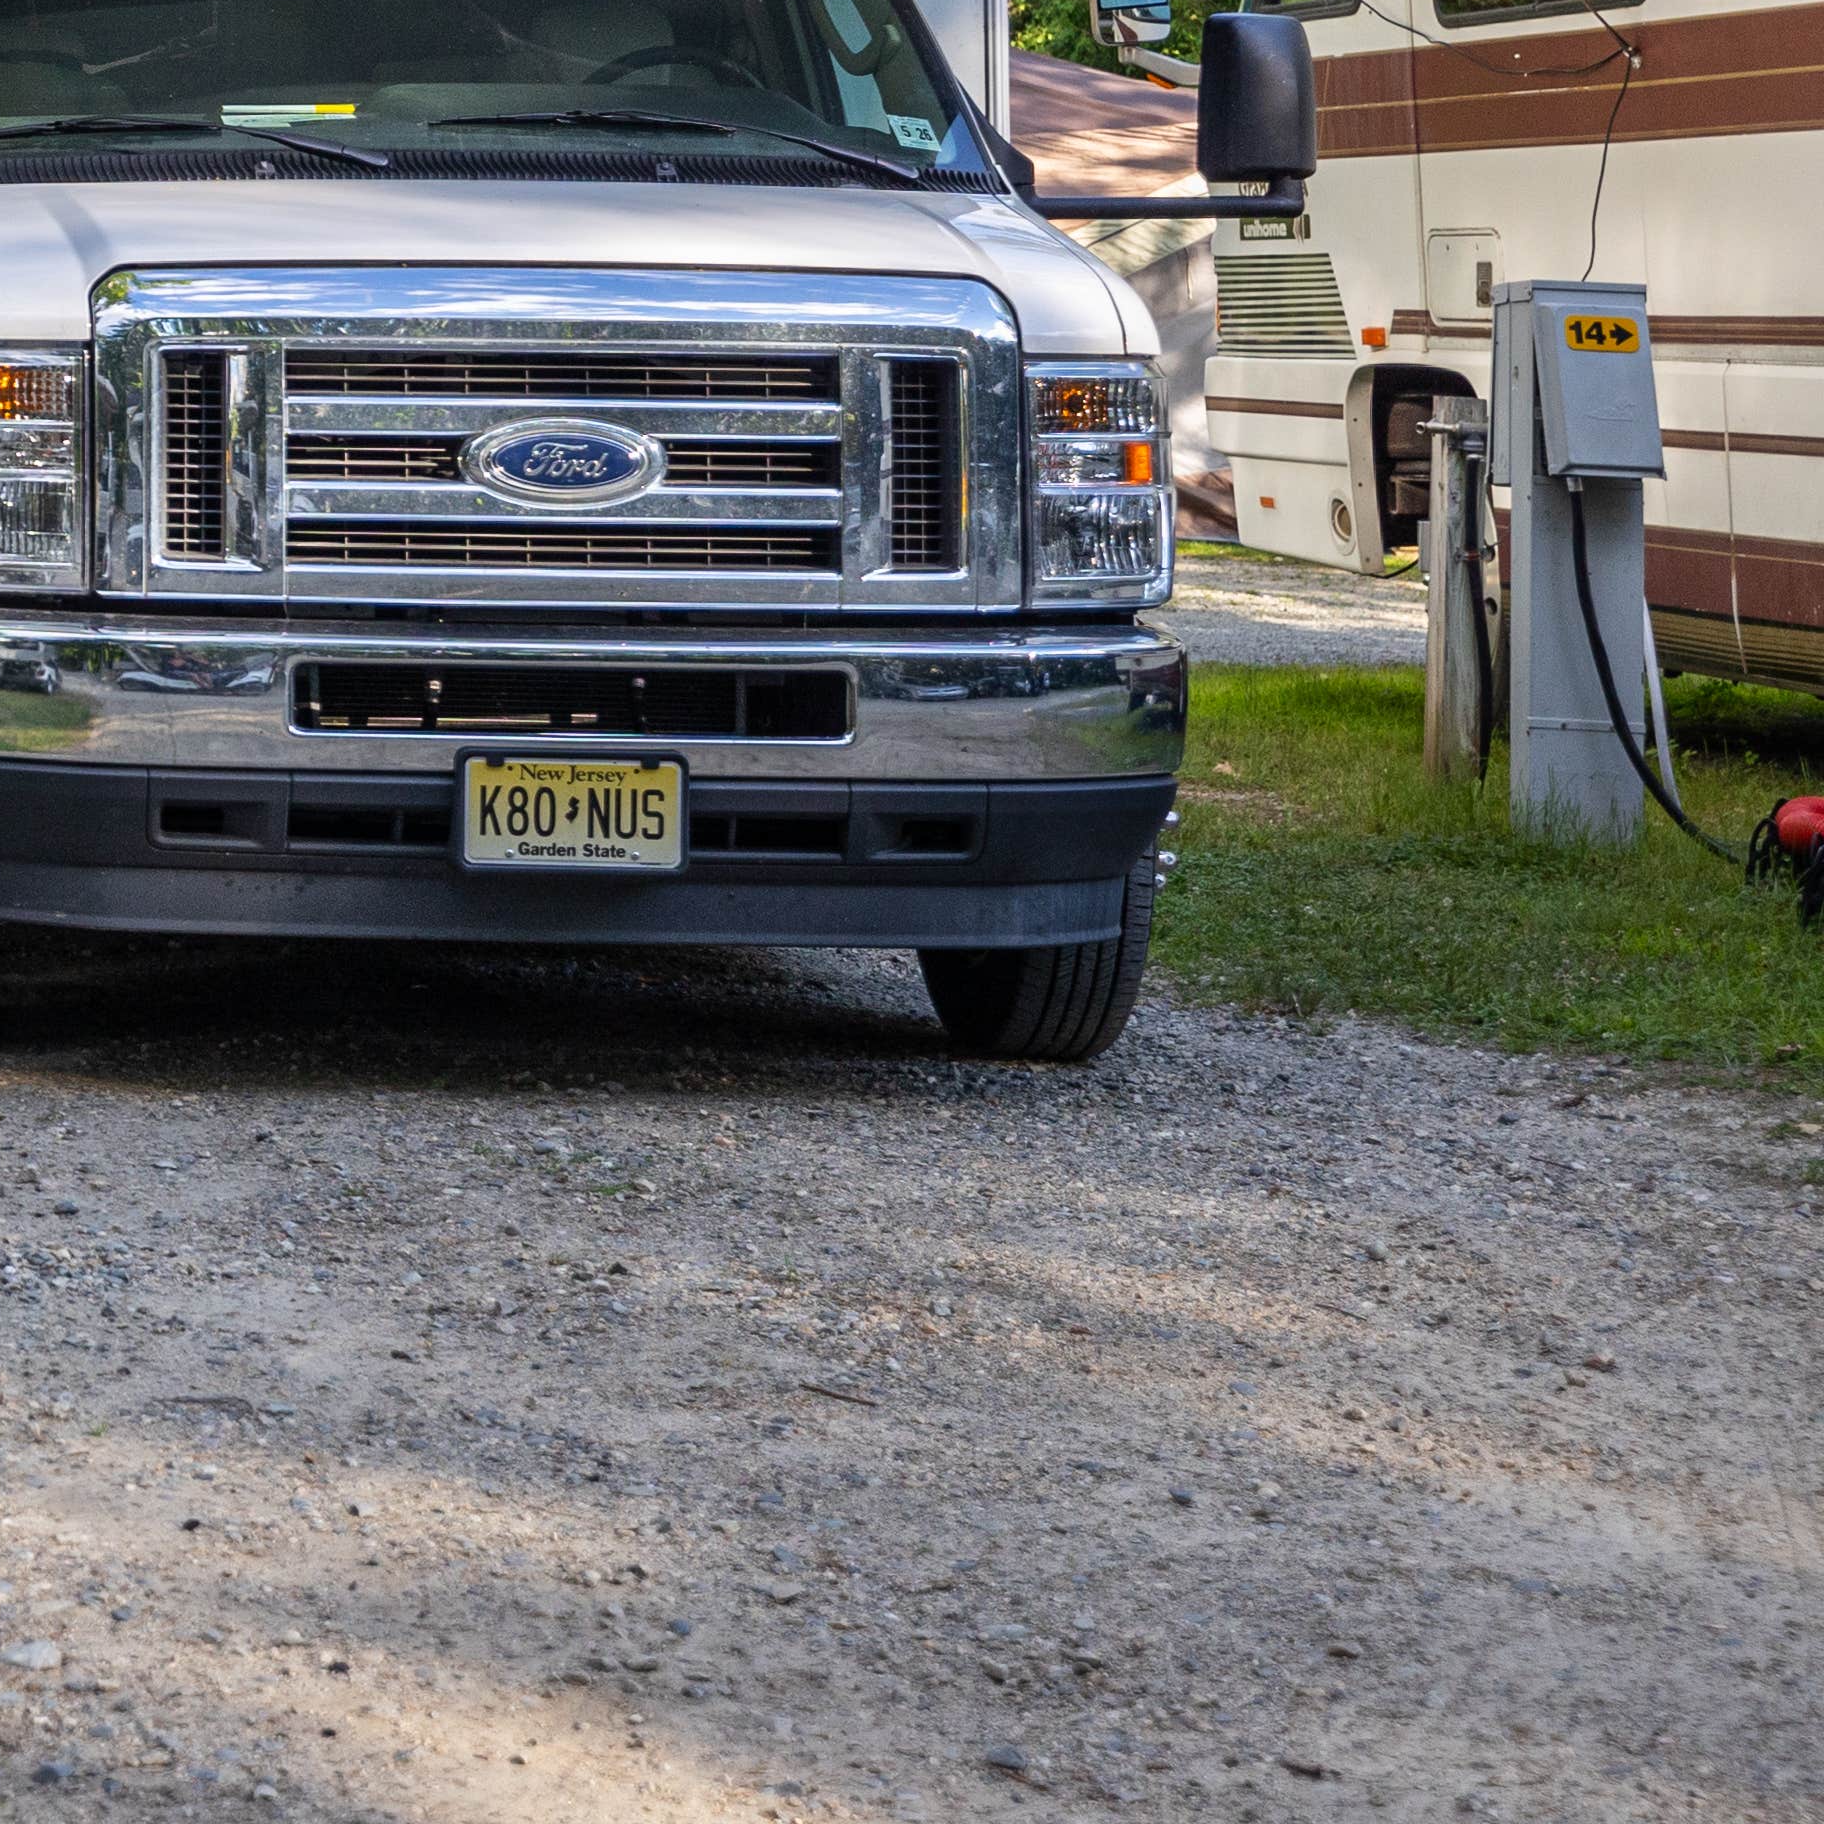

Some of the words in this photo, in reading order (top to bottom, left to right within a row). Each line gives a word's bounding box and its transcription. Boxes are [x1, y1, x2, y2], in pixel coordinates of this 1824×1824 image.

[900, 125, 911, 138] 5
[915, 127, 933, 141] 26
[1243, 218, 1288, 238] unihome
[1569, 321, 1606, 345] 14
[523, 441, 608, 477] Ford
[519, 764, 565, 782] New
[567, 764, 627, 785] Jersey
[479, 784, 557, 837] K80
[587, 787, 665, 840] NUS
[518, 841, 577, 857] Garden
[582, 843, 627, 859] State
